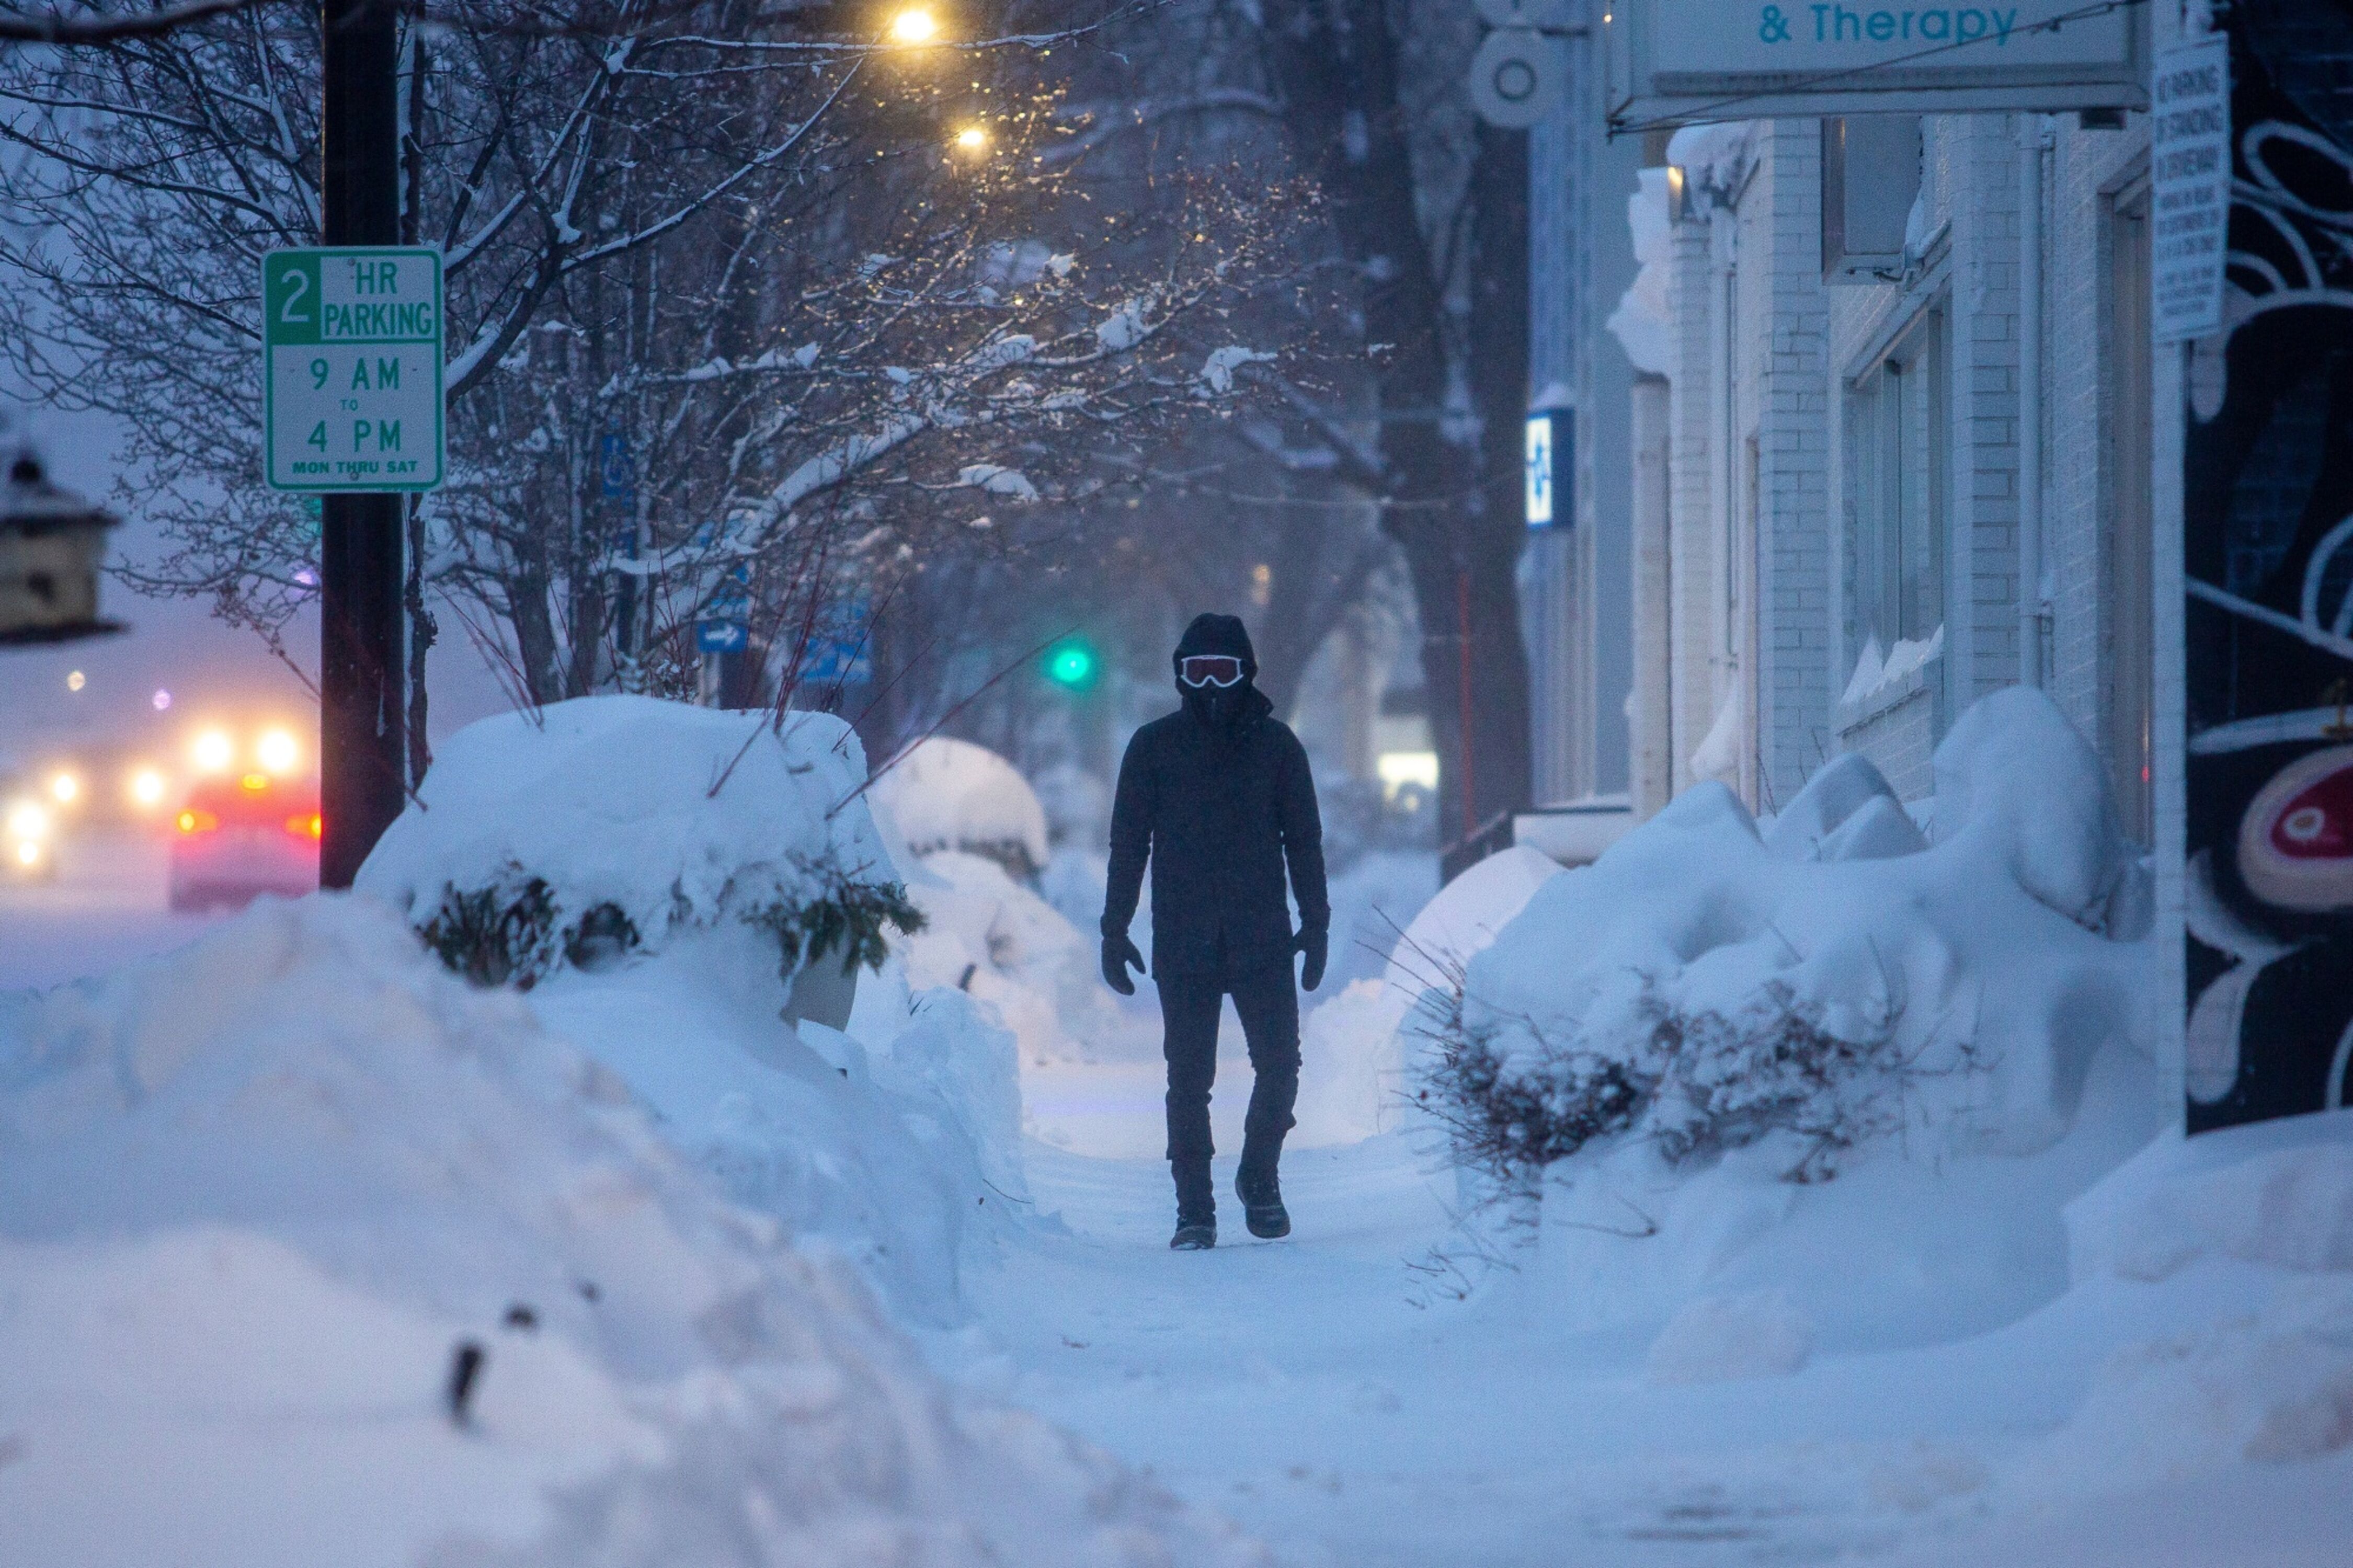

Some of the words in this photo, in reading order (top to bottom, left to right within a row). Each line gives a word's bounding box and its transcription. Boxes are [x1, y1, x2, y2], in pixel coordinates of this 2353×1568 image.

[1758, 4, 1792, 44] &
[1810, 4, 2017, 46] Therapy
[281, 269, 310, 323] 2
[356, 261, 397, 294] HR
[324, 302, 432, 336] PARKING
[310, 358, 329, 389] 9
[351, 358, 399, 390] AM
[340, 399, 358, 411] TO
[307, 420, 328, 452] 4
[353, 420, 401, 452] PM
[292, 462, 329, 473] MON
[337, 461, 379, 473] THRU
[387, 461, 418, 473] SAT
